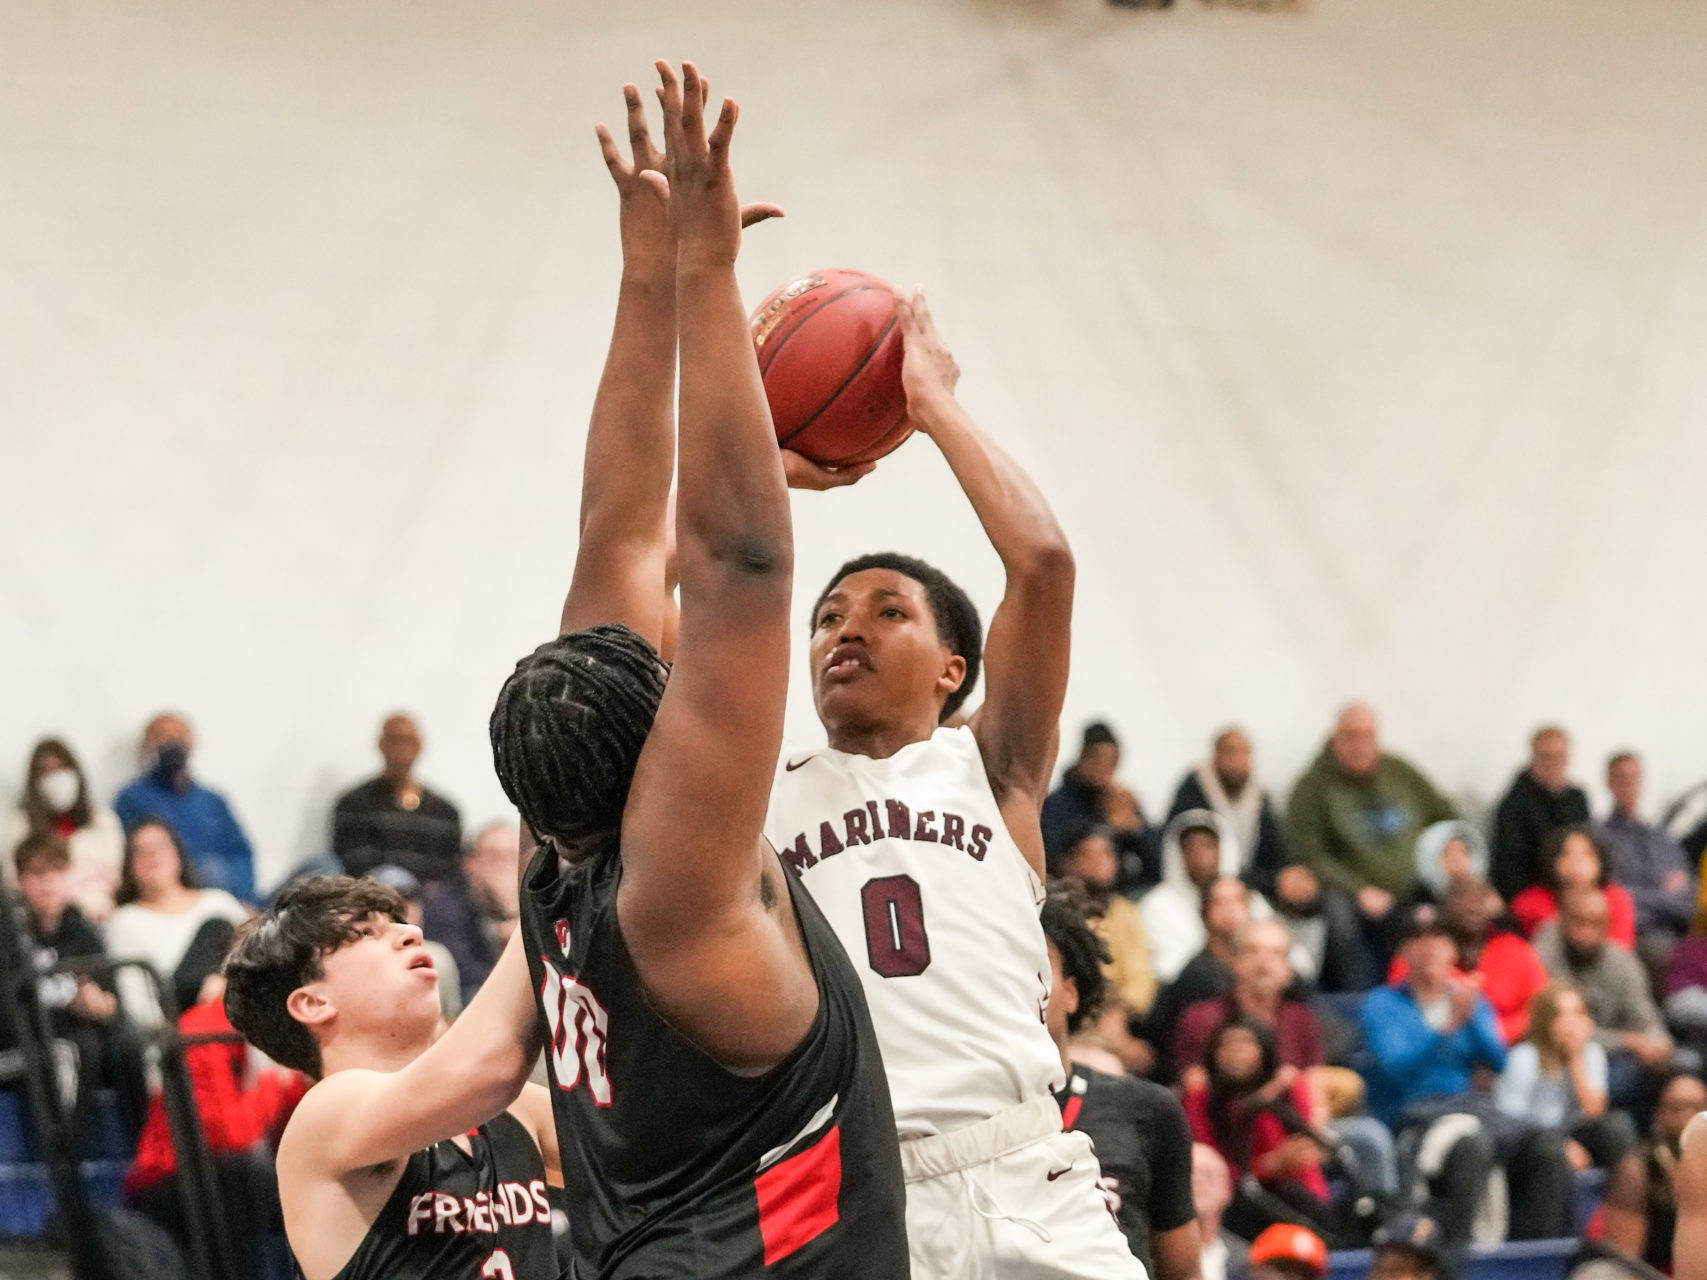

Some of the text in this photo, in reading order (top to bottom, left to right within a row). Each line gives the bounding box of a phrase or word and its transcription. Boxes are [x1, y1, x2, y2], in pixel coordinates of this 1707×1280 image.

[779, 799, 993, 878] MARINERS
[860, 873, 932, 979] 0
[408, 1178, 551, 1236] FRIENDS
